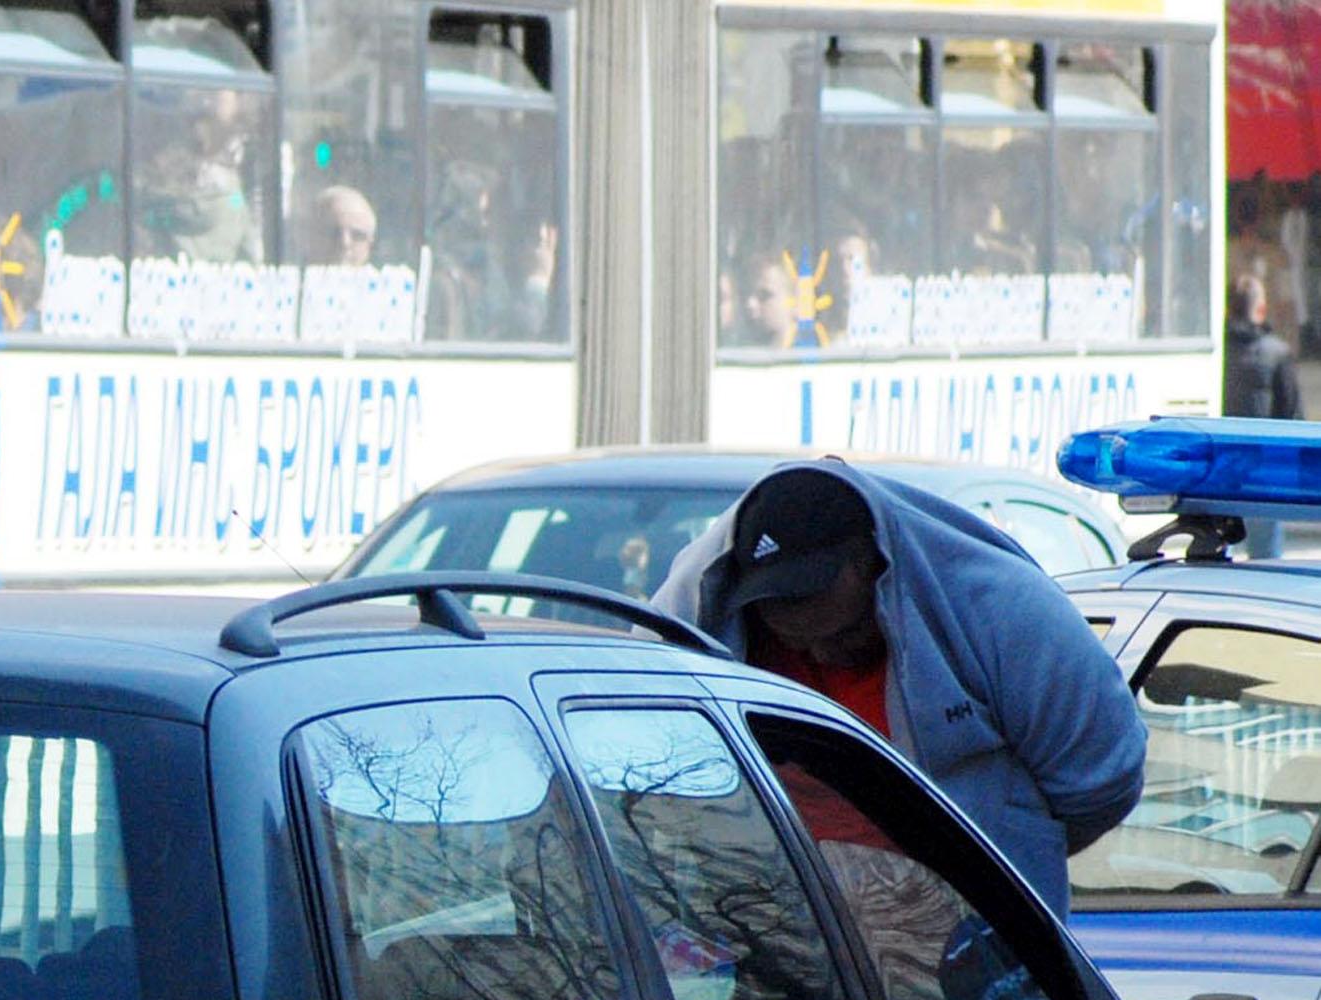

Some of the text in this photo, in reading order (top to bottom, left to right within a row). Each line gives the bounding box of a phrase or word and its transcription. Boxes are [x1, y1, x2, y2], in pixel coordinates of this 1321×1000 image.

[36, 373, 422, 542] ГАЛА ИНС БРОКЕРС
[945, 700, 973, 724] HH
